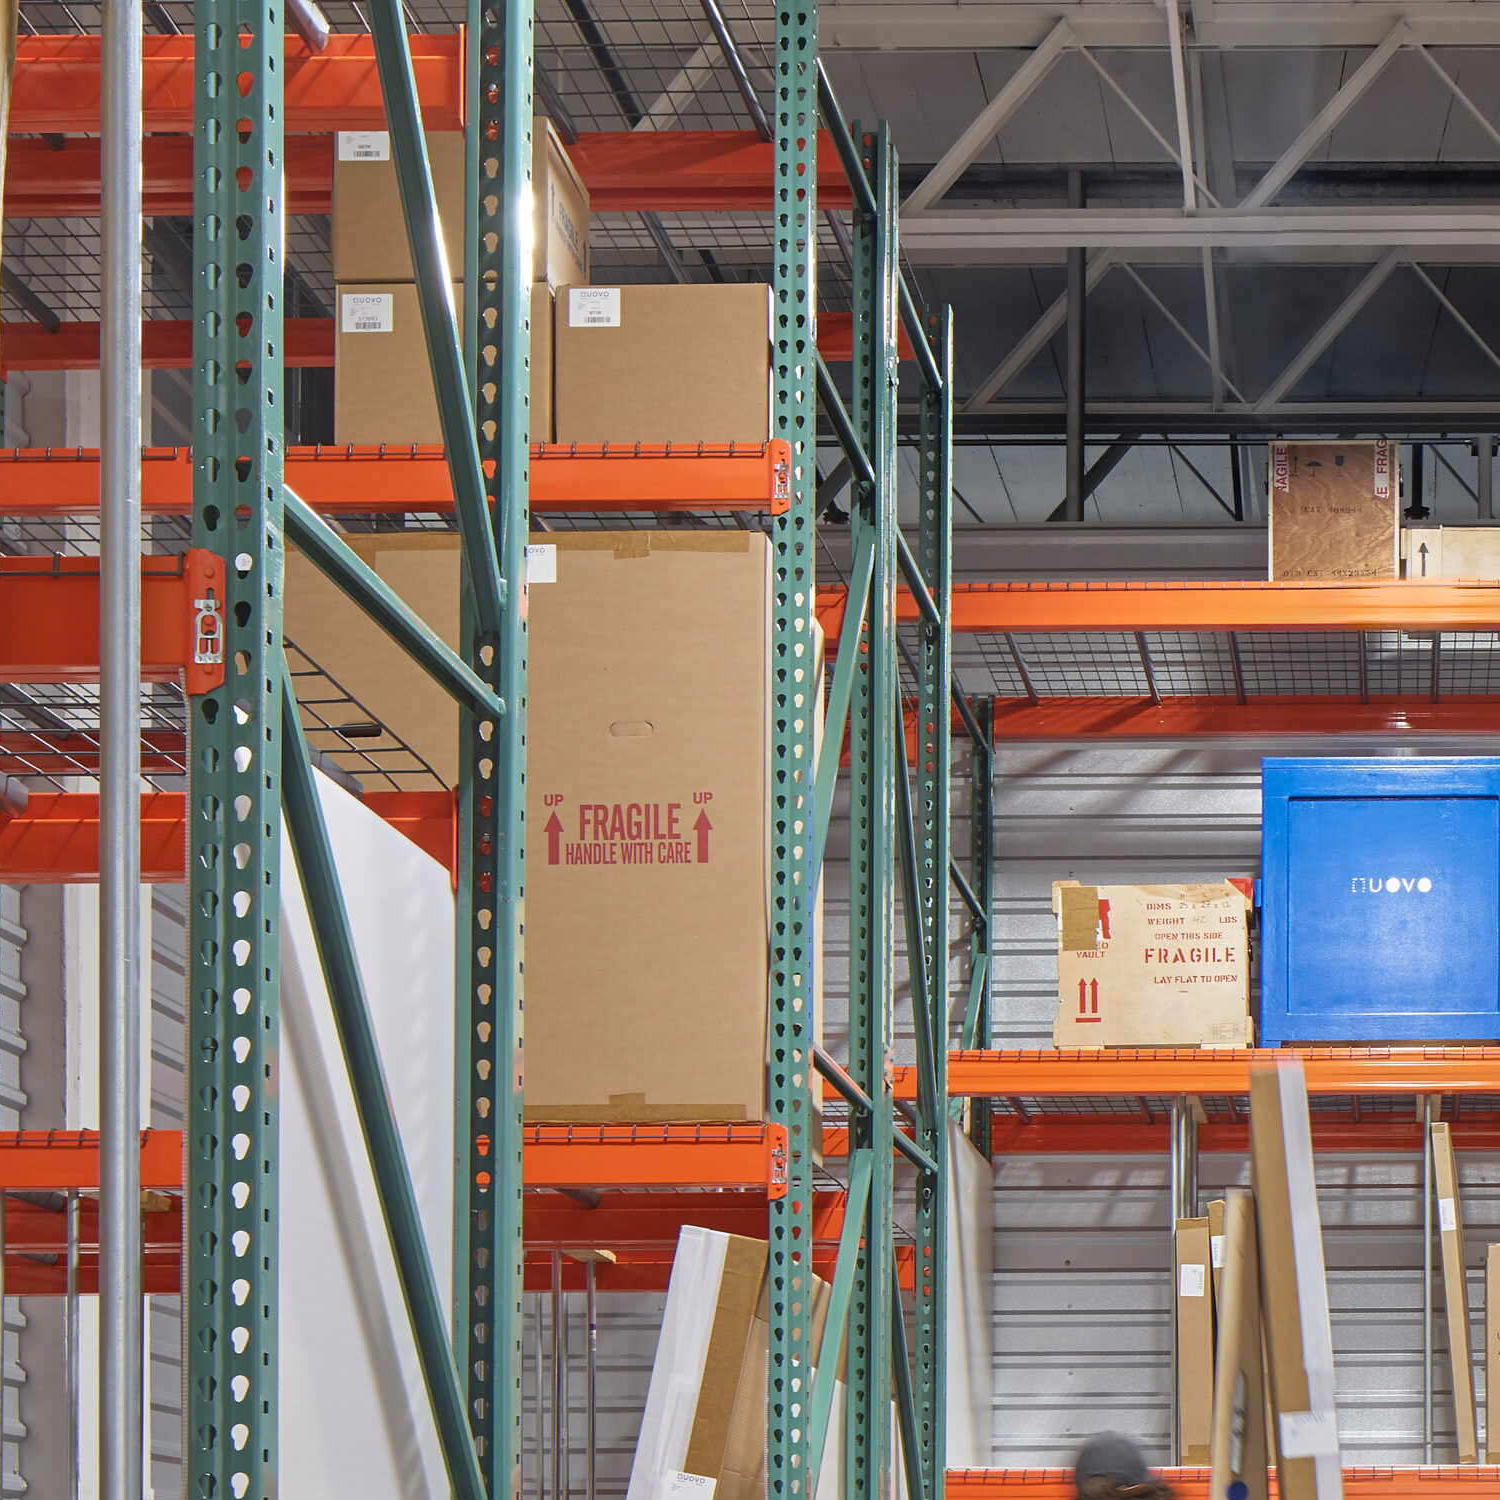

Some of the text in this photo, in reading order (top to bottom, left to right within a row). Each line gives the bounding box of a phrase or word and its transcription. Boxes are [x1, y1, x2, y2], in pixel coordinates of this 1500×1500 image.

[544, 794, 564, 806] UP
[693, 791, 713, 804] UP
[579, 803, 681, 841] FRAGILE
[565, 841, 692, 865] HANDLE WITH CARE
[1369, 877, 1432, 893] UOVO
[1146, 902, 1172, 910] DIMS
[1147, 917, 1185, 925] WEIGHT
[1219, 916, 1238, 924] LBS
[1154, 931, 1224, 940] OPEN THIS SIDE
[1145, 947, 1235, 963] FRAGILE
[1154, 974, 1238, 984] LAY FLAT TO OPEN
